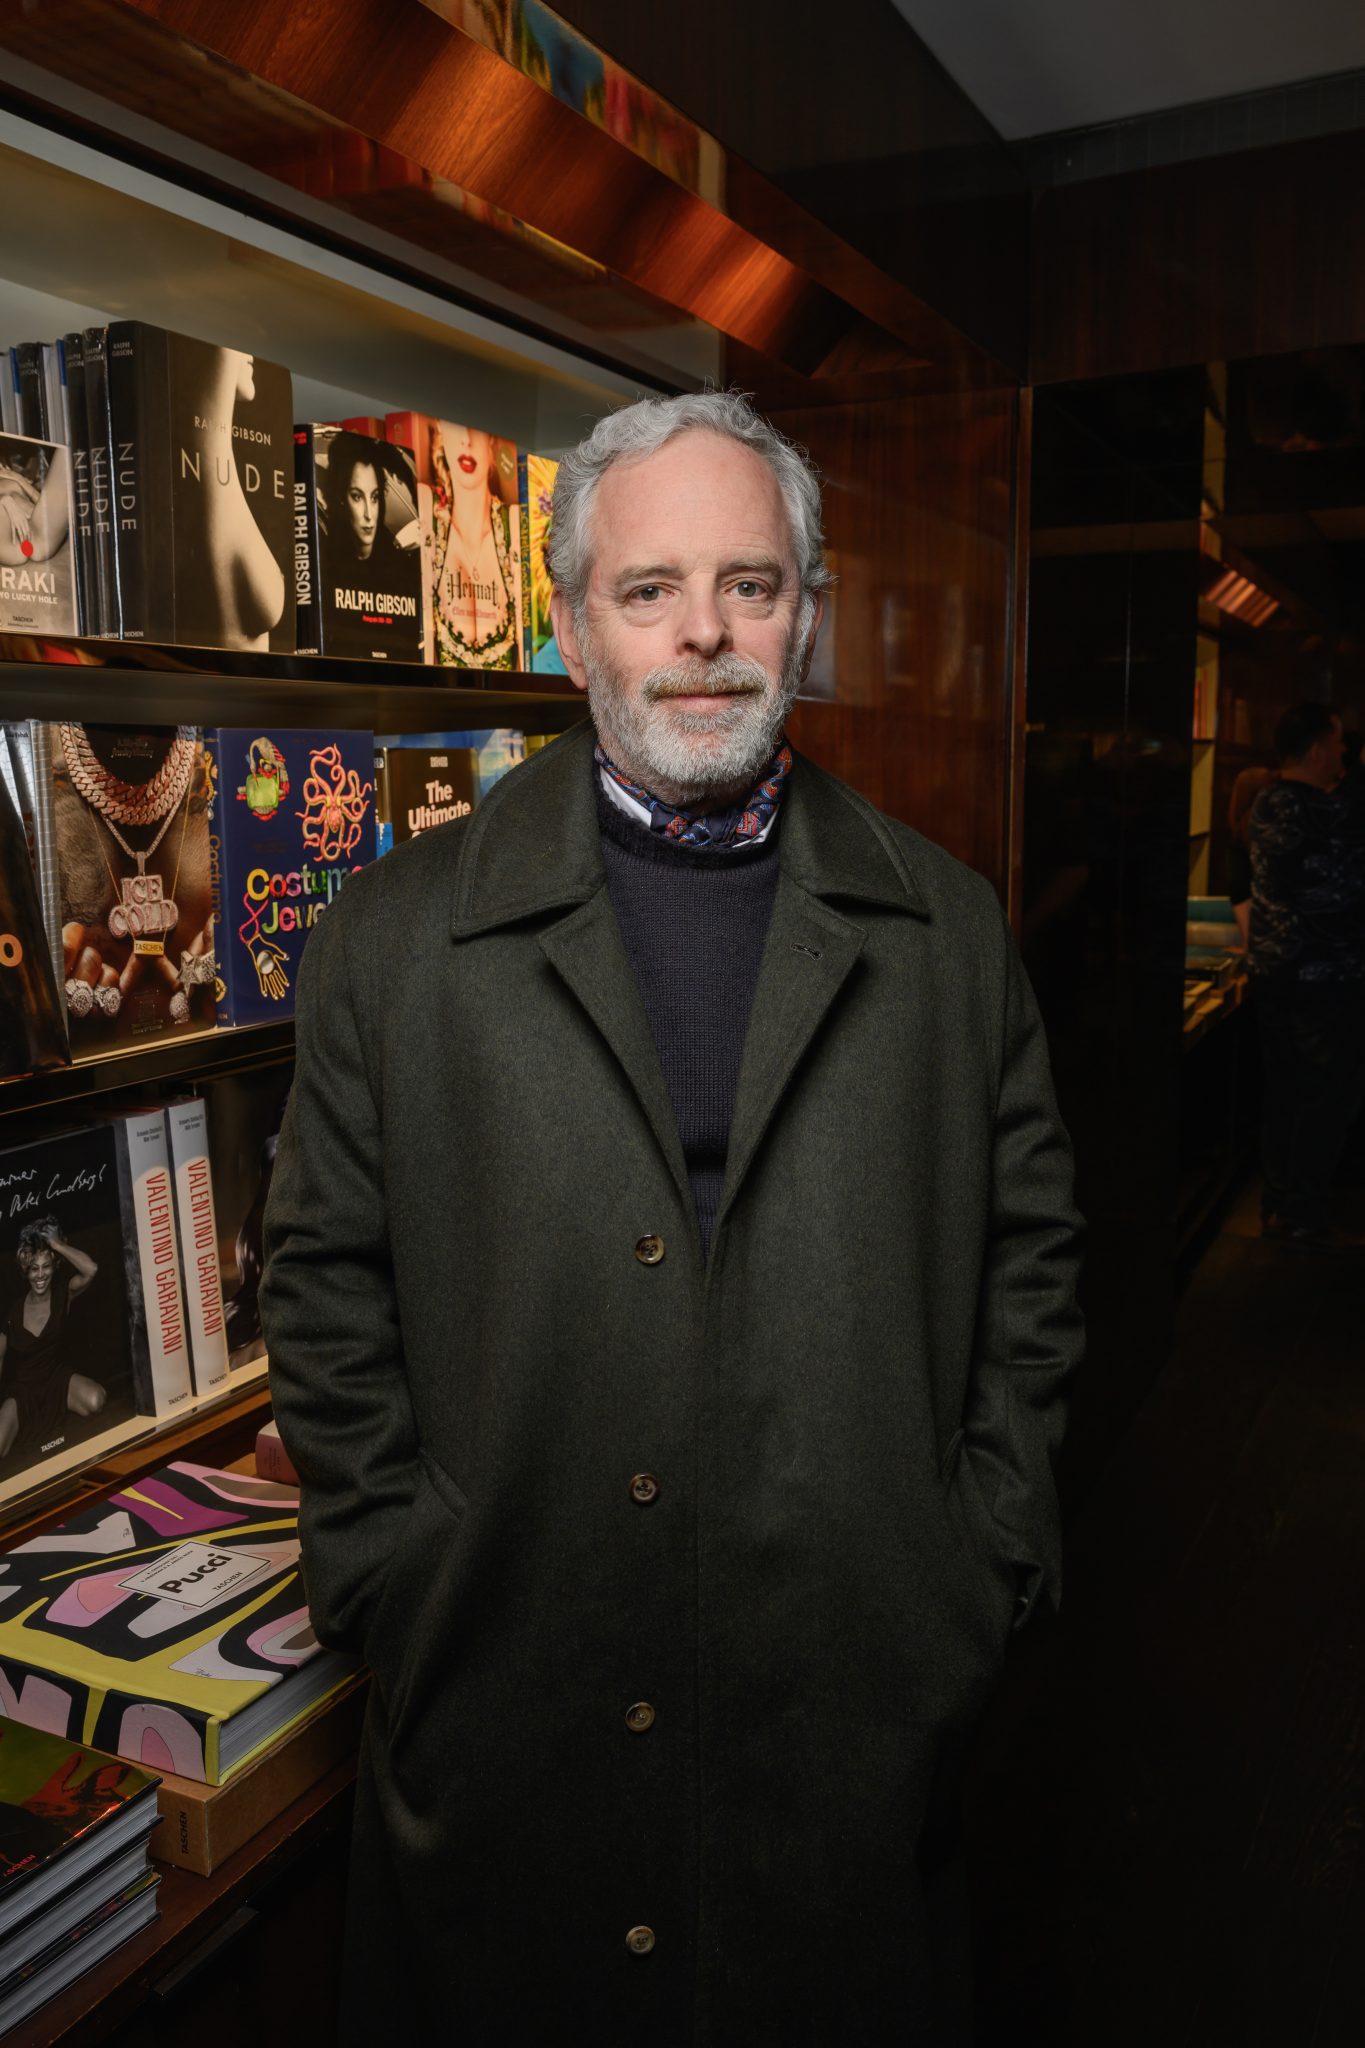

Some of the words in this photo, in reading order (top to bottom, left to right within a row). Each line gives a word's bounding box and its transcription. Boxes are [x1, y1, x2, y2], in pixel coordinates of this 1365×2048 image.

[195, 415, 226, 434] RAH
[232, 425, 271, 446] GIBSON
[91, 446, 110, 533] NUDE
[119, 443, 136, 530] NUDE
[181, 447, 285, 499] NUDE
[294, 543, 311, 605] GIBSON
[450, 571, 497, 606] Heimat
[12, 594, 36, 602] LUCKY
[38, 596, 58, 604] HOLE
[335, 588, 374, 612] RALPH
[375, 593, 416, 616] GIBSON
[425, 780, 453, 804] The
[408, 800, 472, 831] Ultimate
[247, 863, 364, 904] Costum
[108, 900, 178, 938] COLD
[135, 943, 163, 952] TASCHEN
[146, 1172, 174, 1265] VALENTINO
[187, 1159, 214, 1250] VALENTINO
[155, 1268, 183, 1356] GARAVANI
[197, 1253, 223, 1337] GARAVANI
[41, 1436, 65, 1452] TASCHEN
[157, 1553, 232, 1593] Pucci
[212, 1571, 243, 1591] TASCHEN
[180, 1811, 188, 1855] TASCHEN
